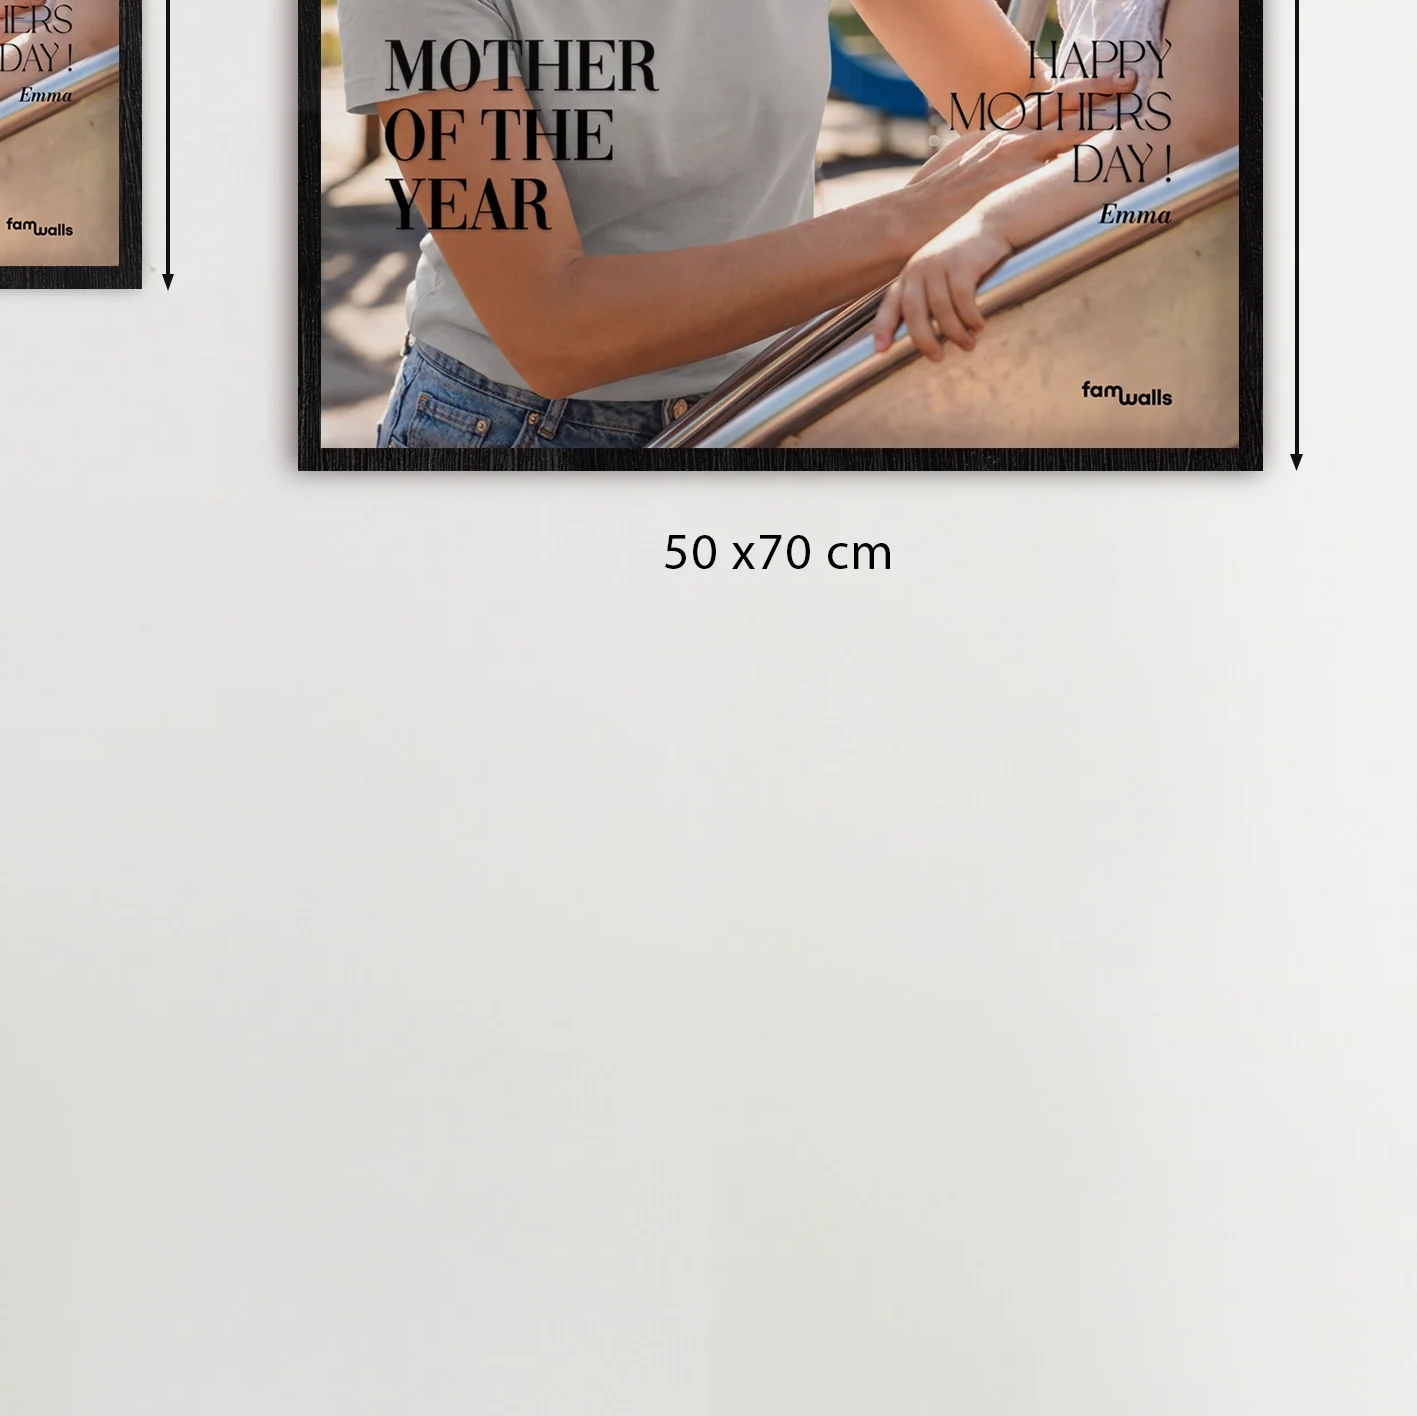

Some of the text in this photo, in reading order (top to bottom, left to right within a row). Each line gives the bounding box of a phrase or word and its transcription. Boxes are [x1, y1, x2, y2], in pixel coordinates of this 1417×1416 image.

[384, 38, 660, 92] MOTHER
[1029, 38, 1173, 79] HAPPY
[19, 86, 73, 103] Emma
[950, 90, 1173, 131] MOTHERS
[384, 108, 613, 161] OF THE
[384, 178, 553, 231] YEAR
[1098, 203, 1173, 224] Emma
